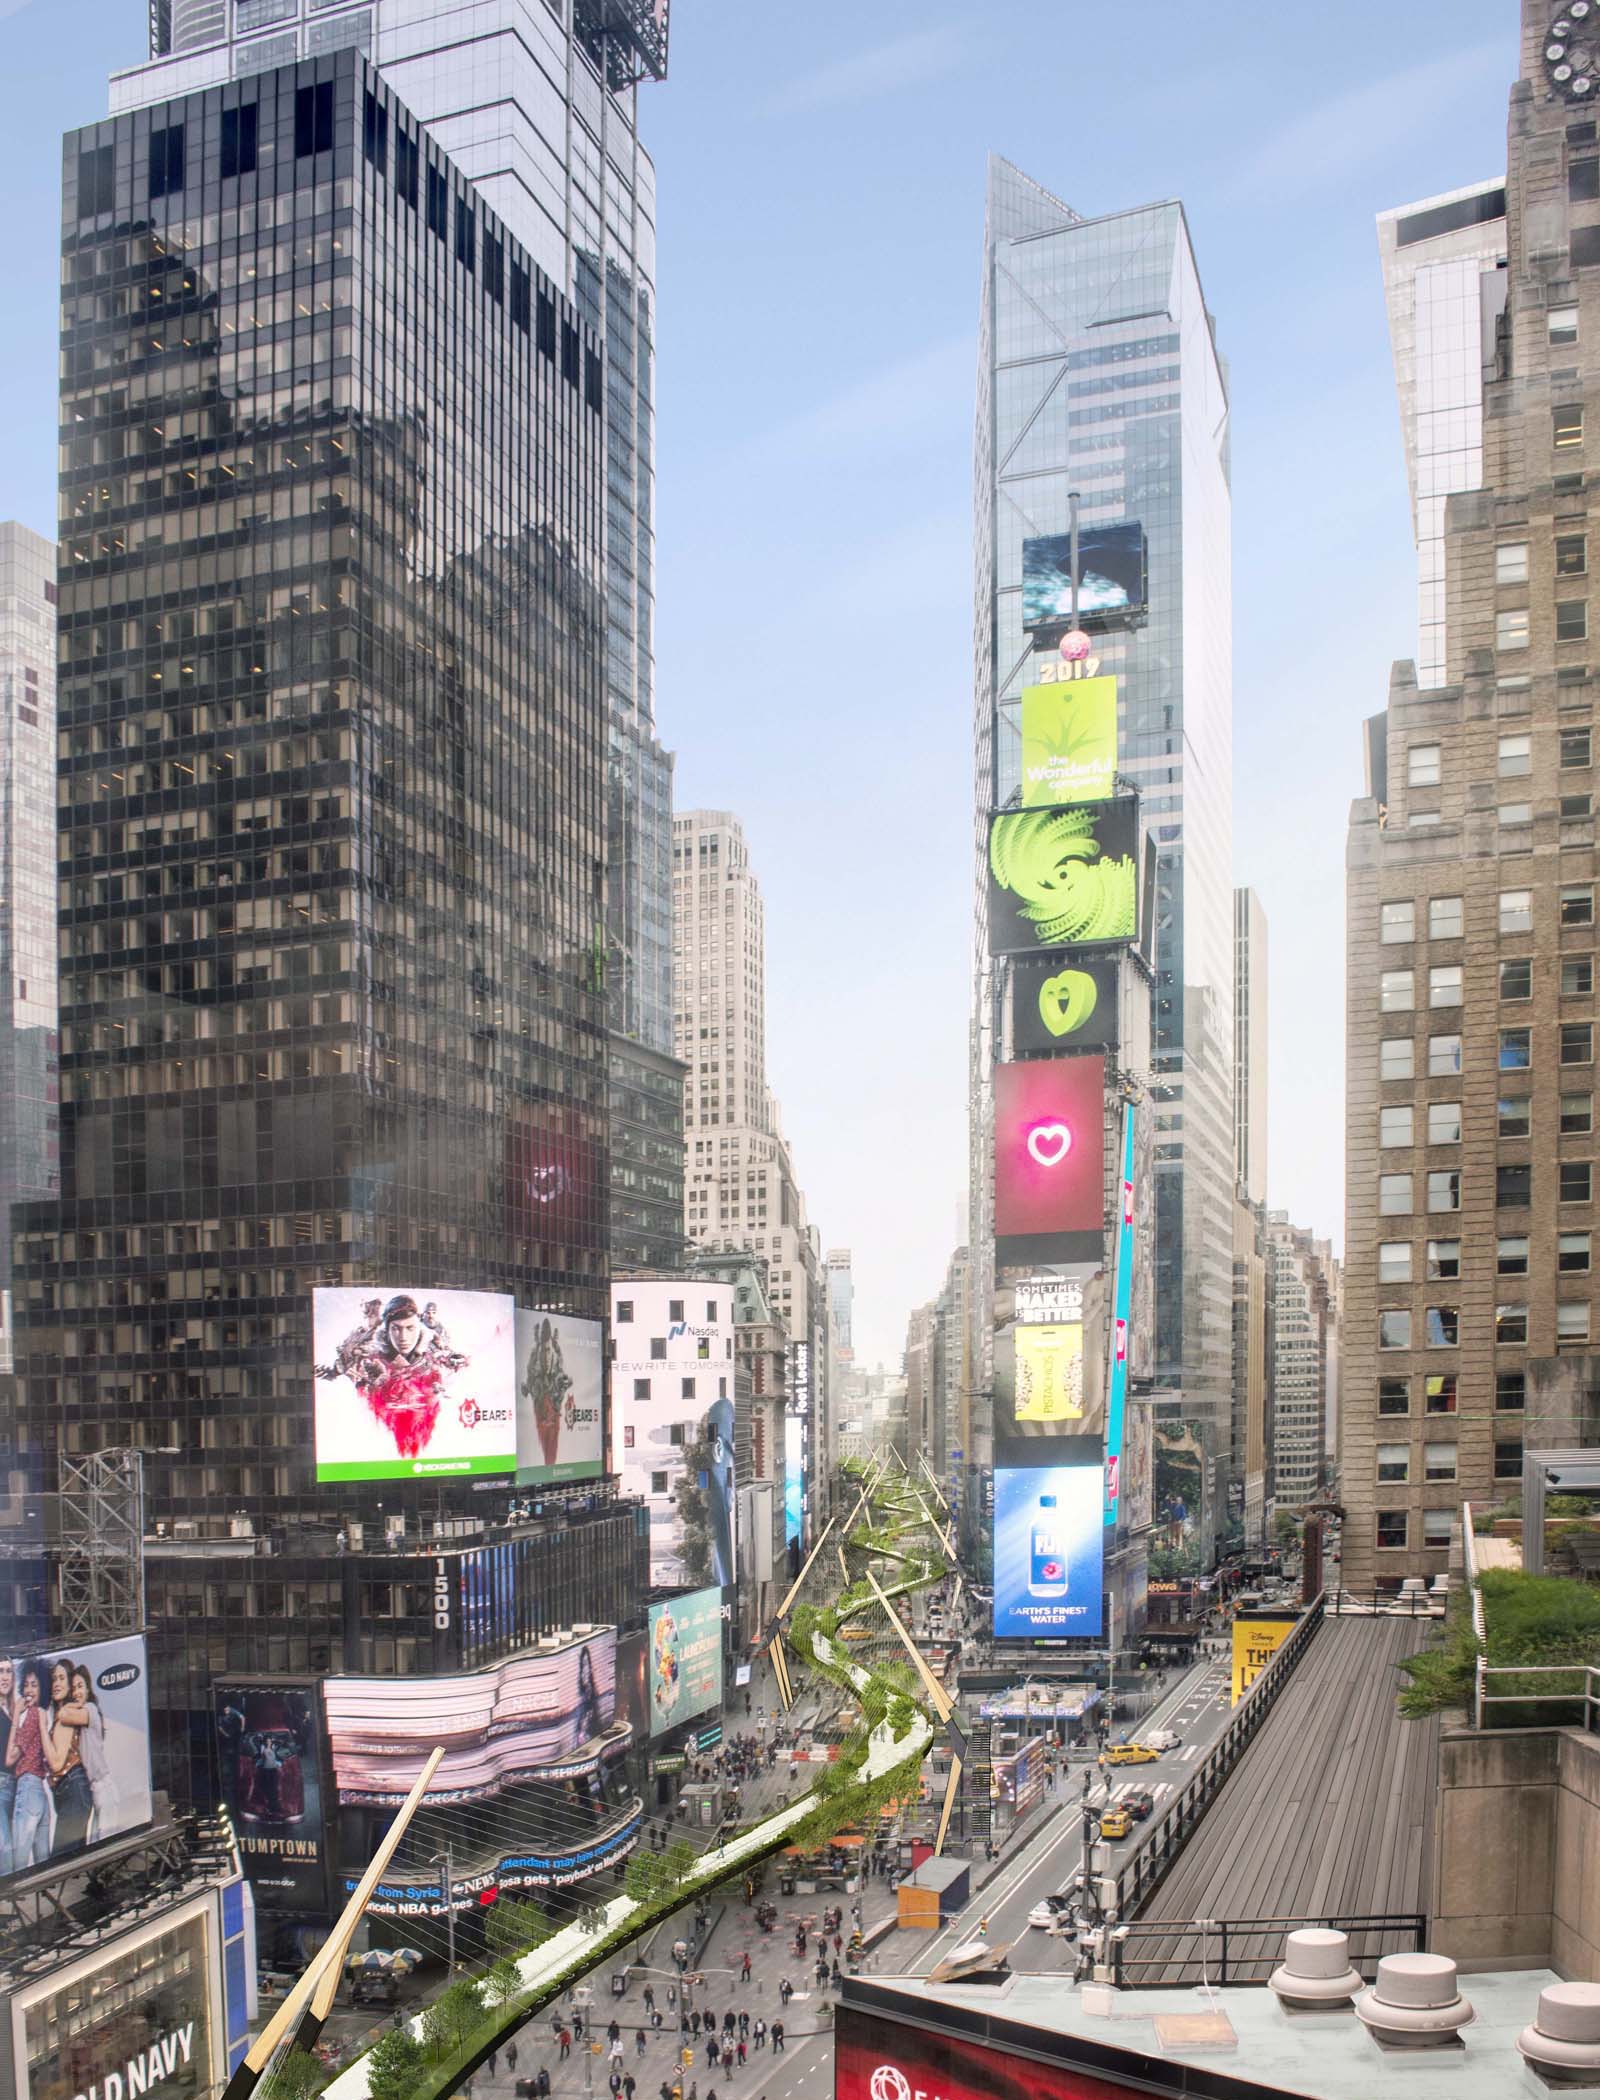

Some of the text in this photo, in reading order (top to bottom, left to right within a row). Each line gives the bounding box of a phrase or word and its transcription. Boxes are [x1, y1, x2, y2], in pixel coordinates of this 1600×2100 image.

[1039, 658, 1100, 685] 2019
[1048, 755, 1068, 766] the
[1026, 757, 1113, 781] Wonderful
[1015, 1292, 1083, 1309] NAKED
[1024, 1307, 1082, 1322] BETTER
[688, 1326, 719, 1337] Nasdaq
[612, 1361, 677, 1372] REWRITE
[795, 1344, 808, 1385] Locker
[795, 1386, 808, 1414] Foot
[474, 1410, 507, 1421] GEARS
[572, 1409, 592, 1422] GEARS
[434, 1558, 450, 1630] 1500
[1009, 1606, 1088, 1615] EARTH'S FINEST
[1030, 1615, 1067, 1624] WATER
[1248, 1632, 1274, 1641] Disney
[101, 1668, 136, 1686] OLD NAVY
[239, 1837, 317, 1856] TUMPTOWN
[553, 1858, 576, 1869] may
[464, 1872, 496, 1894] NEWS
[523, 1873, 550, 1886] gets
[406, 1887, 441, 1901] Syria
[399, 1903, 429, 1915] NBA
[127, 2021, 194, 2100] NAVY
